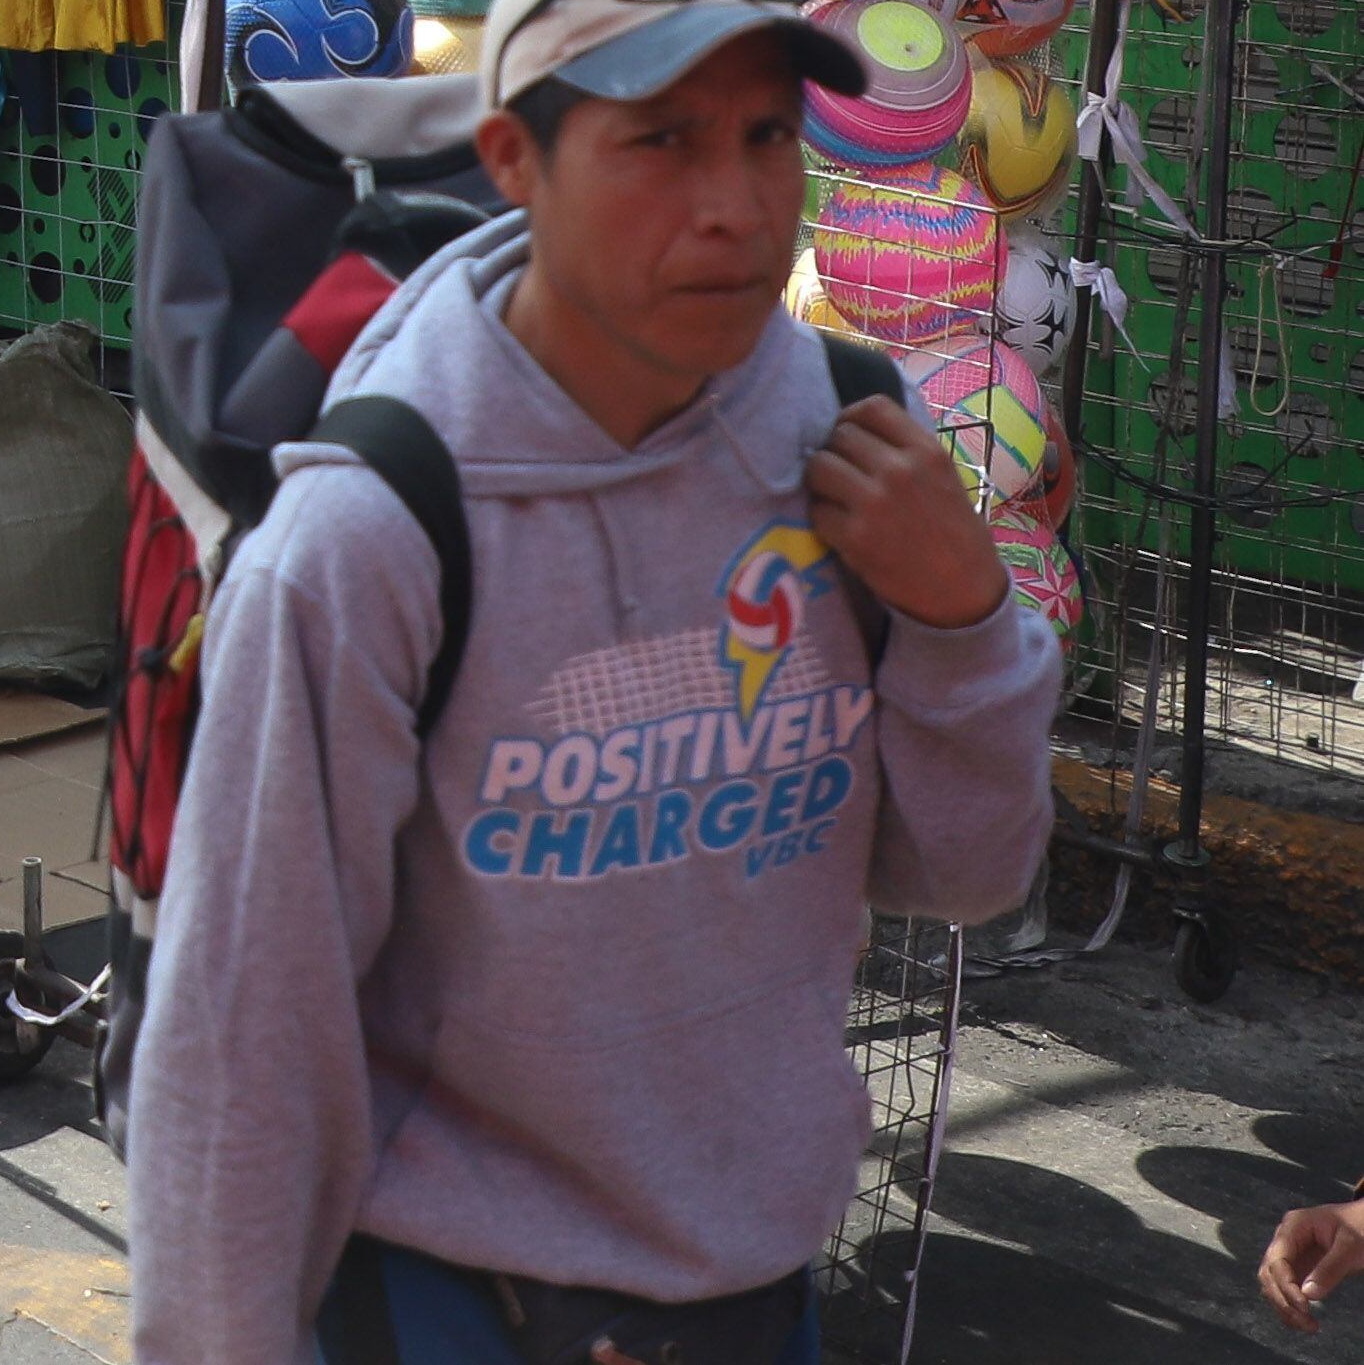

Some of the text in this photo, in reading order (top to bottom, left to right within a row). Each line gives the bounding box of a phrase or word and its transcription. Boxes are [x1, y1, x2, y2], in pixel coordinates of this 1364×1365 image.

[481, 685, 874, 806] POSITIVELY
[464, 753, 855, 879] CHARGED
[744, 818, 838, 881] VBC
